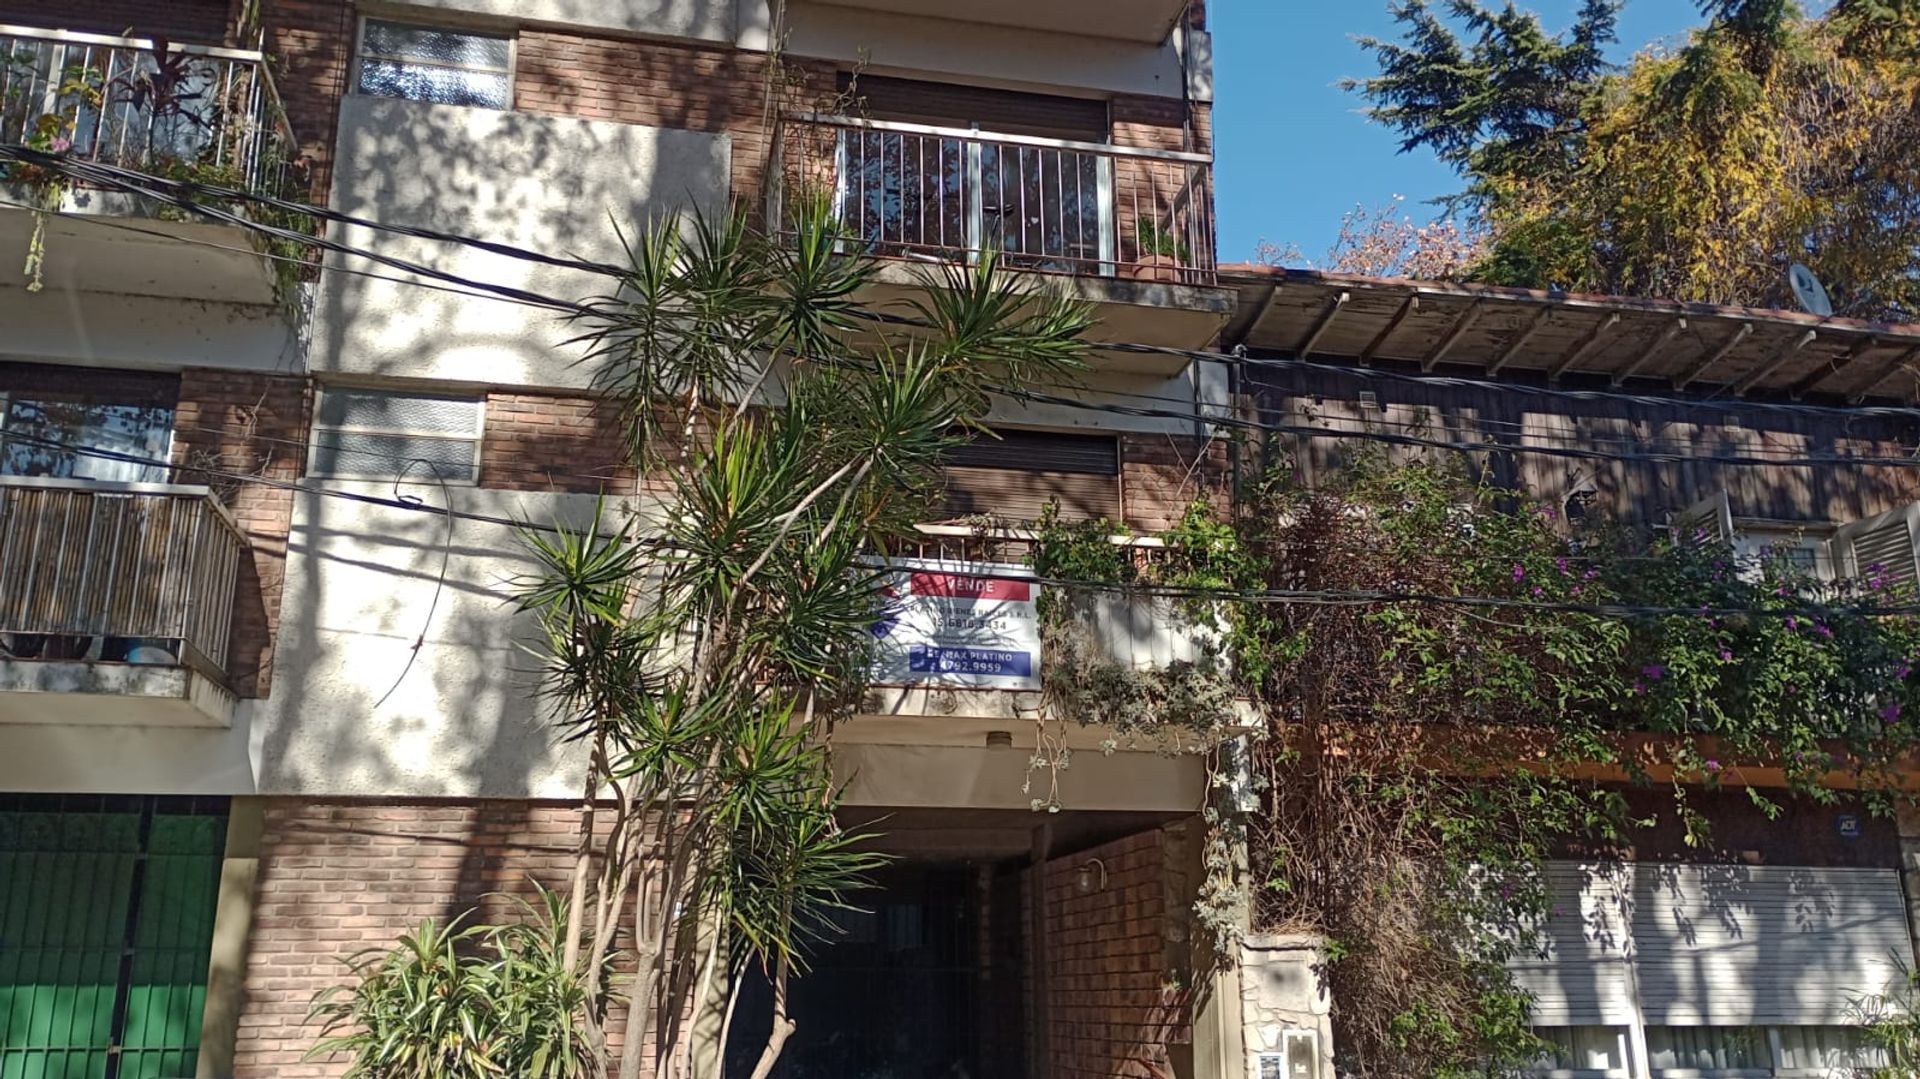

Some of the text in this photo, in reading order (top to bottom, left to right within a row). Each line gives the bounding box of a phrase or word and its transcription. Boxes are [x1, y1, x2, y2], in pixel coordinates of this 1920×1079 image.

[946, 578, 995, 592] VENDE
[970, 651, 1013, 662] PLATINO
[939, 659, 1002, 673] 4792.9959
